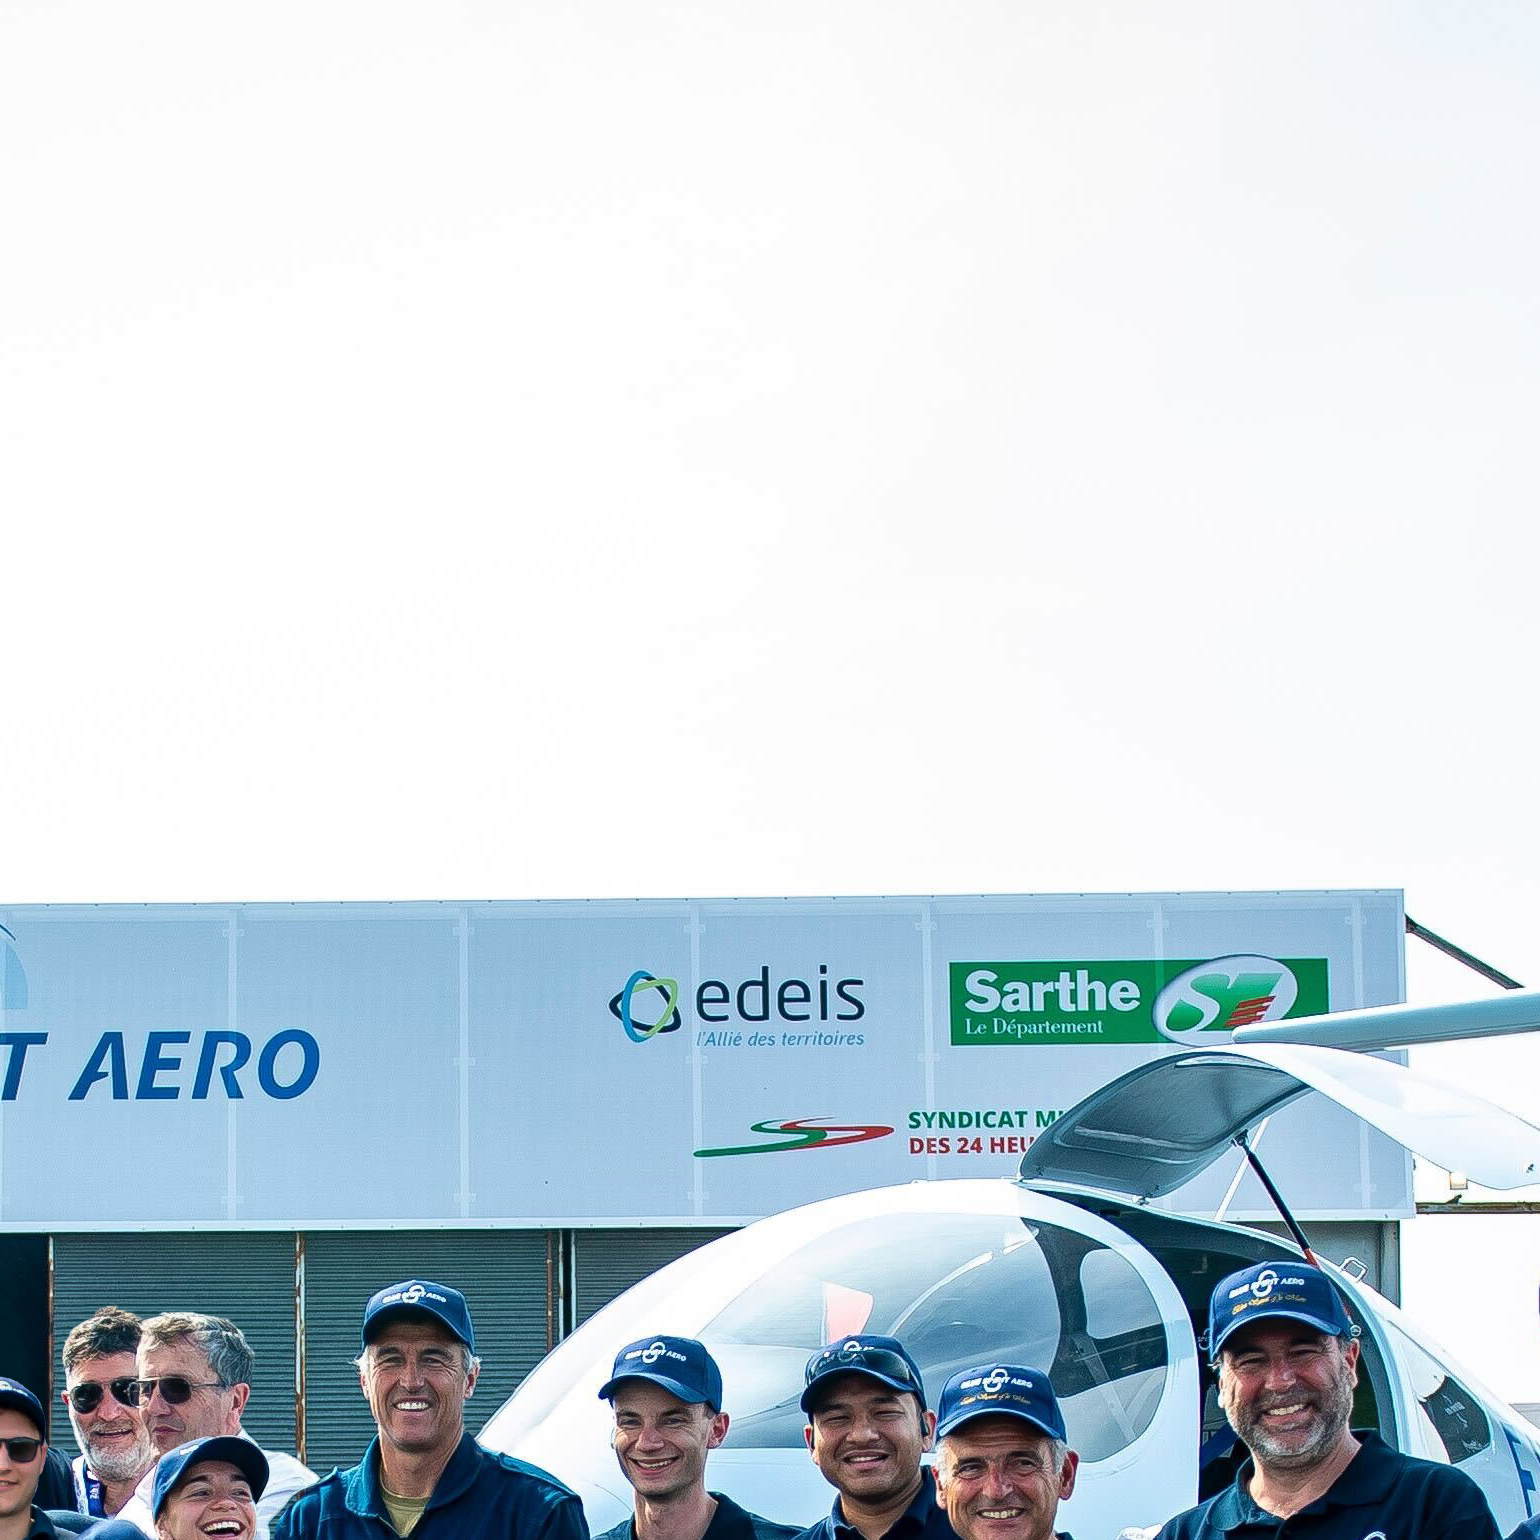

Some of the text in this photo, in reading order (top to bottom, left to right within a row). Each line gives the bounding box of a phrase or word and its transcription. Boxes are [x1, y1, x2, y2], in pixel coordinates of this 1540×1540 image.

[696, 964, 865, 1023] edeis
[964, 969, 1141, 1013] Sarthe
[964, 1017, 1105, 1038] Le Département
[696, 1030, 865, 1047] l'Allié des territoires
[68, 1028, 321, 1102] AERO
[908, 1110, 1066, 1129] SYNDICAT M
[909, 1136, 951, 1154] DES
[956, 1136, 984, 1154] 24
